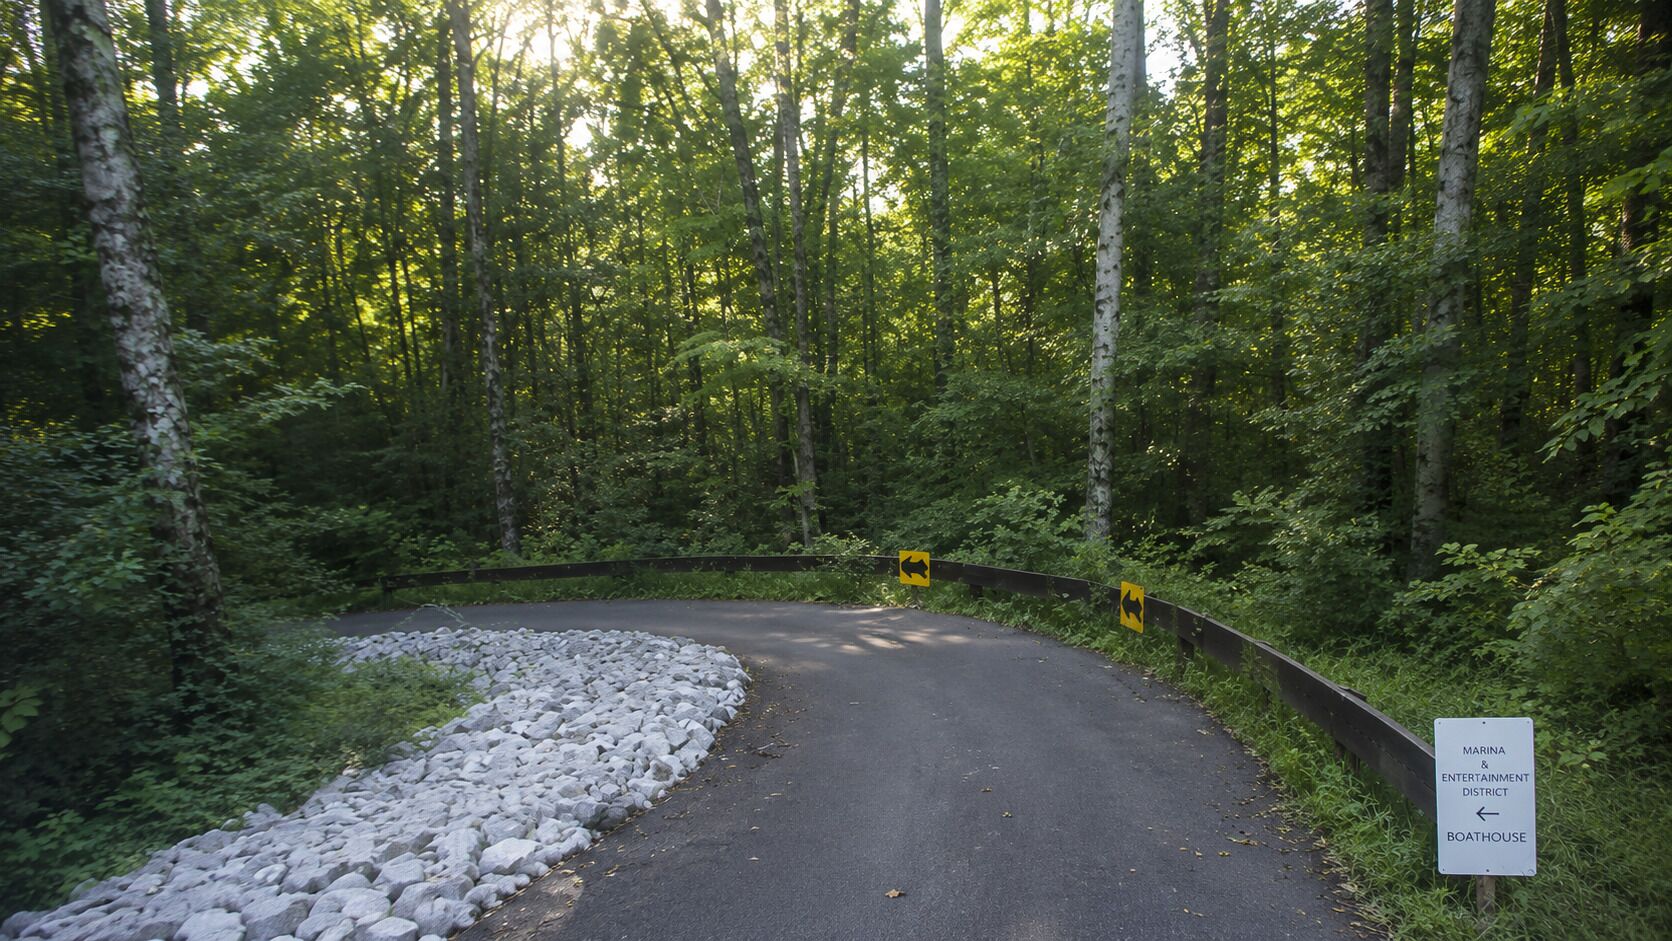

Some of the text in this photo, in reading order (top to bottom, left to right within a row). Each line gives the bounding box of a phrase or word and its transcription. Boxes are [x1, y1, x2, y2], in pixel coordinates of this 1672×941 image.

[1463, 746, 1506, 755] MARINA
[1480, 760, 1489, 769] &
[1441, 773, 1530, 783] ENTERTAINMENT
[1462, 787, 1509, 797] DISTRICT
[1447, 831, 1527, 843] BOATHOUSE
